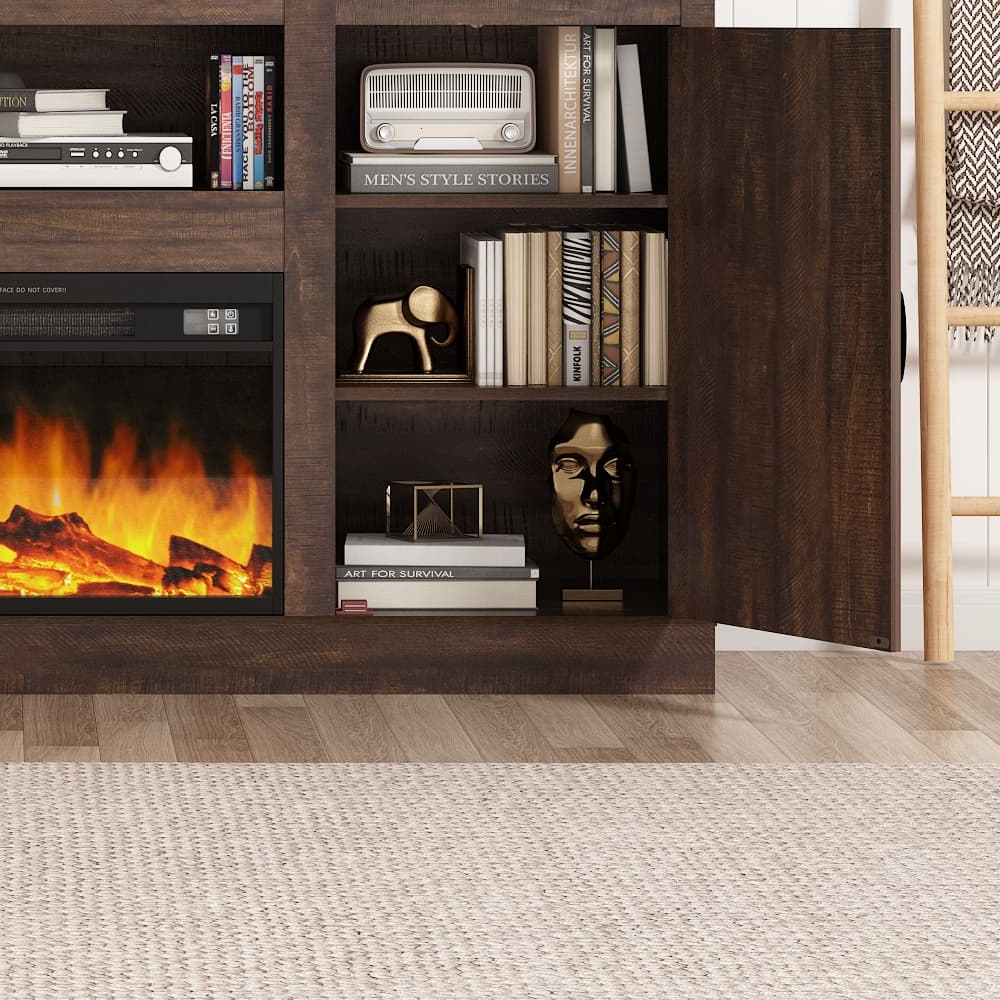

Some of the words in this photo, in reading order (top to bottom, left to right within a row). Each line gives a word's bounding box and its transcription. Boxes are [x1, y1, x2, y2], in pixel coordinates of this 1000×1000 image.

[583, 32, 591, 51] ART
[583, 55, 591, 75] FOR
[210, 104, 218, 114] LA
[243, 94, 248, 111] TO
[563, 33, 577, 175] INNENARCHITEKTUR
[583, 78, 591, 123] SURVIVAL
[364, 172, 416, 186] MEN'S
[420, 173, 473, 185] STYLE
[477, 173, 549, 186] STORIES
[572, 346, 581, 382] KINFOLK
[344, 570, 367, 578] ART
[371, 570, 396, 578] FOR
[400, 570, 455, 578] SURVIVAL
